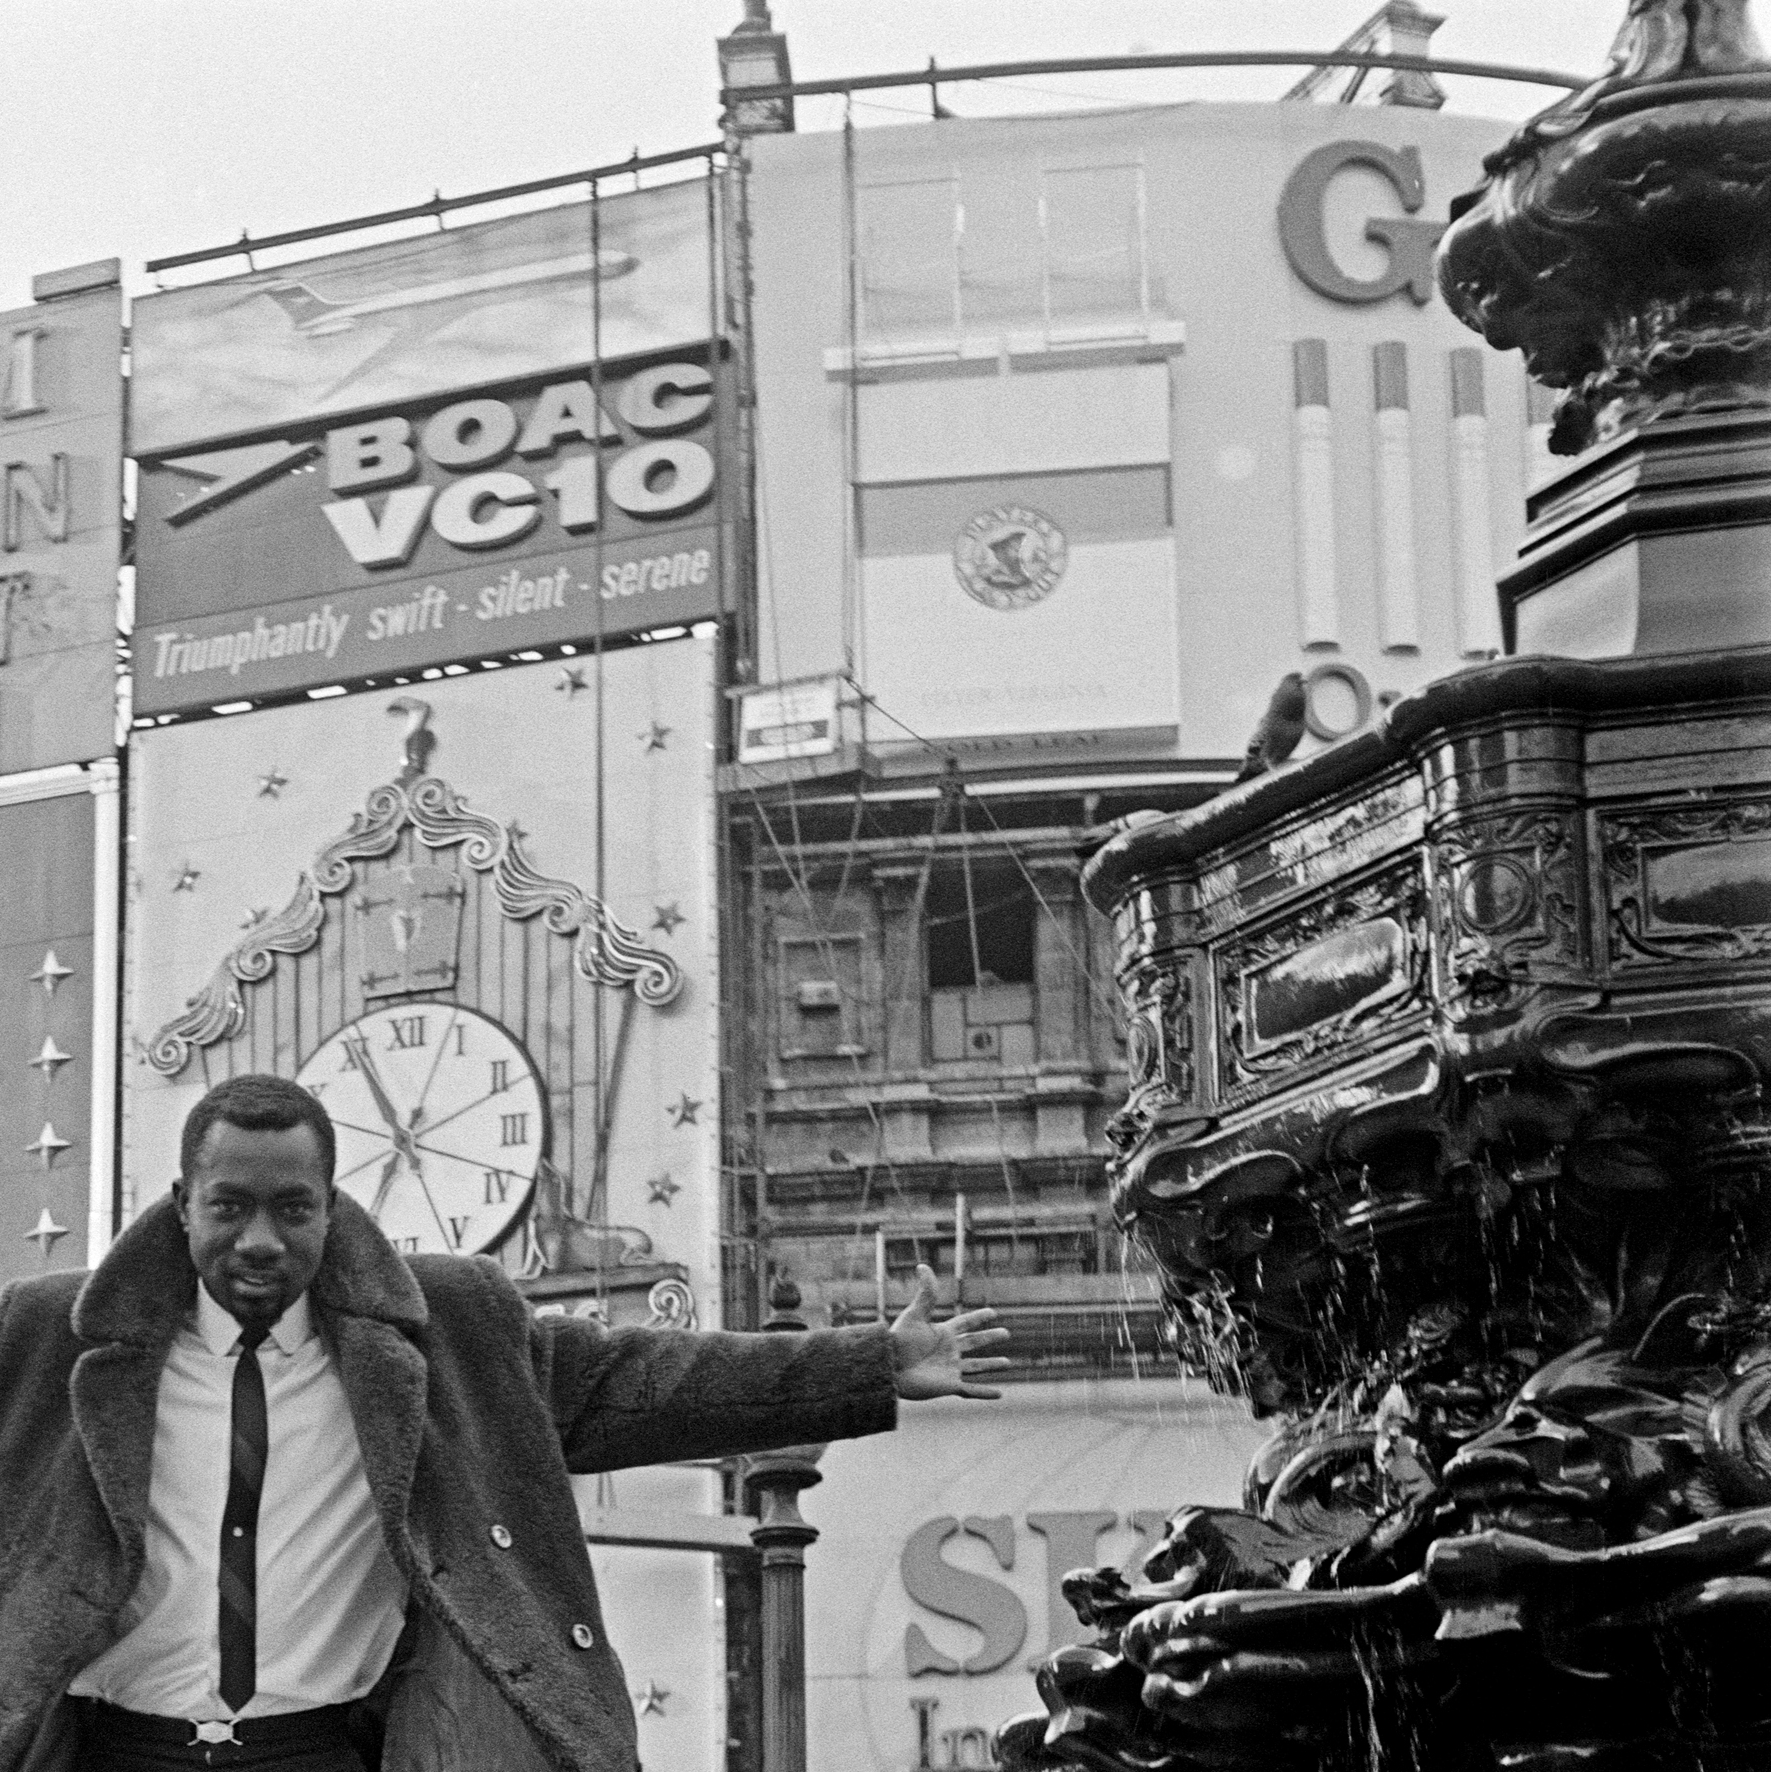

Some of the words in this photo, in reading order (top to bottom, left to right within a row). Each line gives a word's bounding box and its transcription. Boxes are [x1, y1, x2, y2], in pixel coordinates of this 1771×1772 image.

[325, 362, 713, 494] BOAC
[321, 438, 715, 569] VC10
[153, 606, 349, 677] Triumphantly
[367, 587, 449, 641] swift
[475, 565, 569, 620] silent
[602, 550, 710, 598] serene
[385, 1015, 428, 1051] XII
[499, 1112, 530, 1148] III
